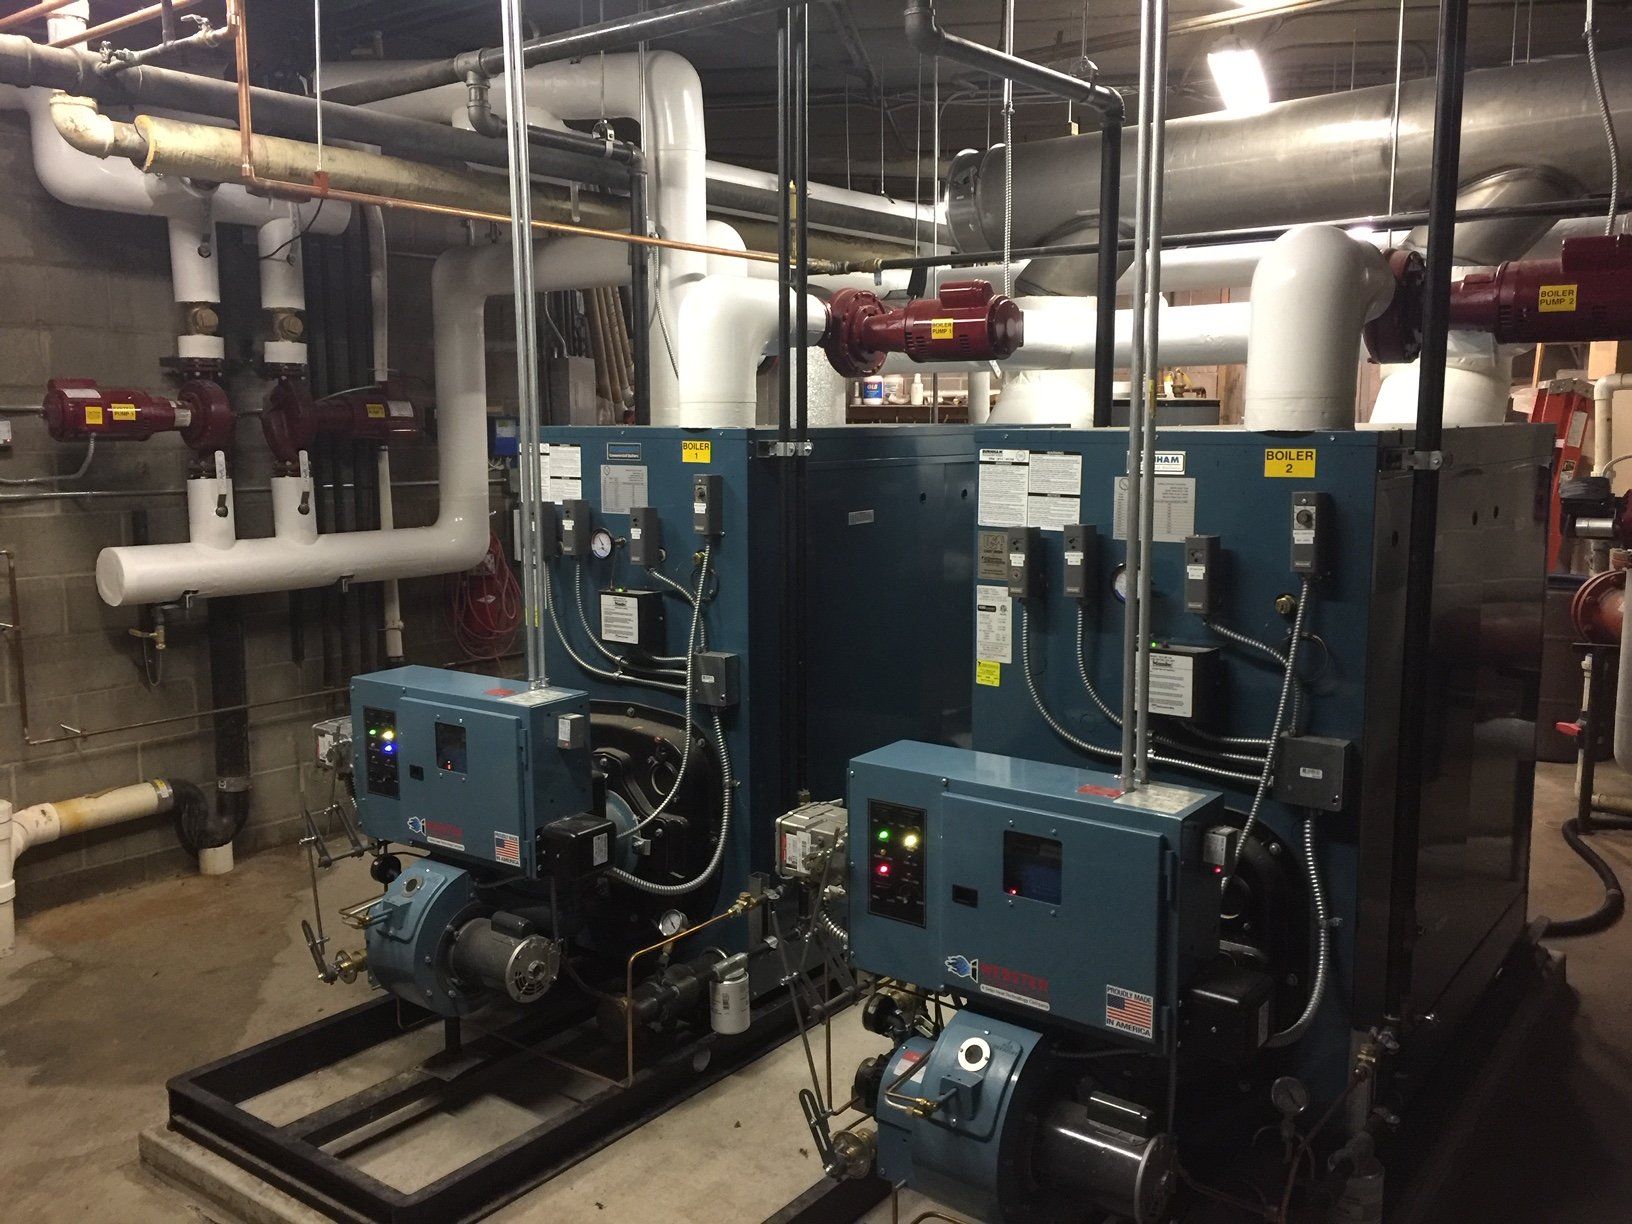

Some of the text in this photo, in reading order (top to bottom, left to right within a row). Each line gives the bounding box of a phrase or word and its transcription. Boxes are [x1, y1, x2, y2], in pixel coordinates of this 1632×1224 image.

[1541, 289, 1575, 297] BOILER
[683, 442, 710, 451] BOILER
[1266, 450, 1314, 461] BOILER
[1285, 463, 1293, 474] 2
[1106, 986, 1152, 1004] PROUDLY MADE
[1115, 1021, 1151, 1036] AMERICA
